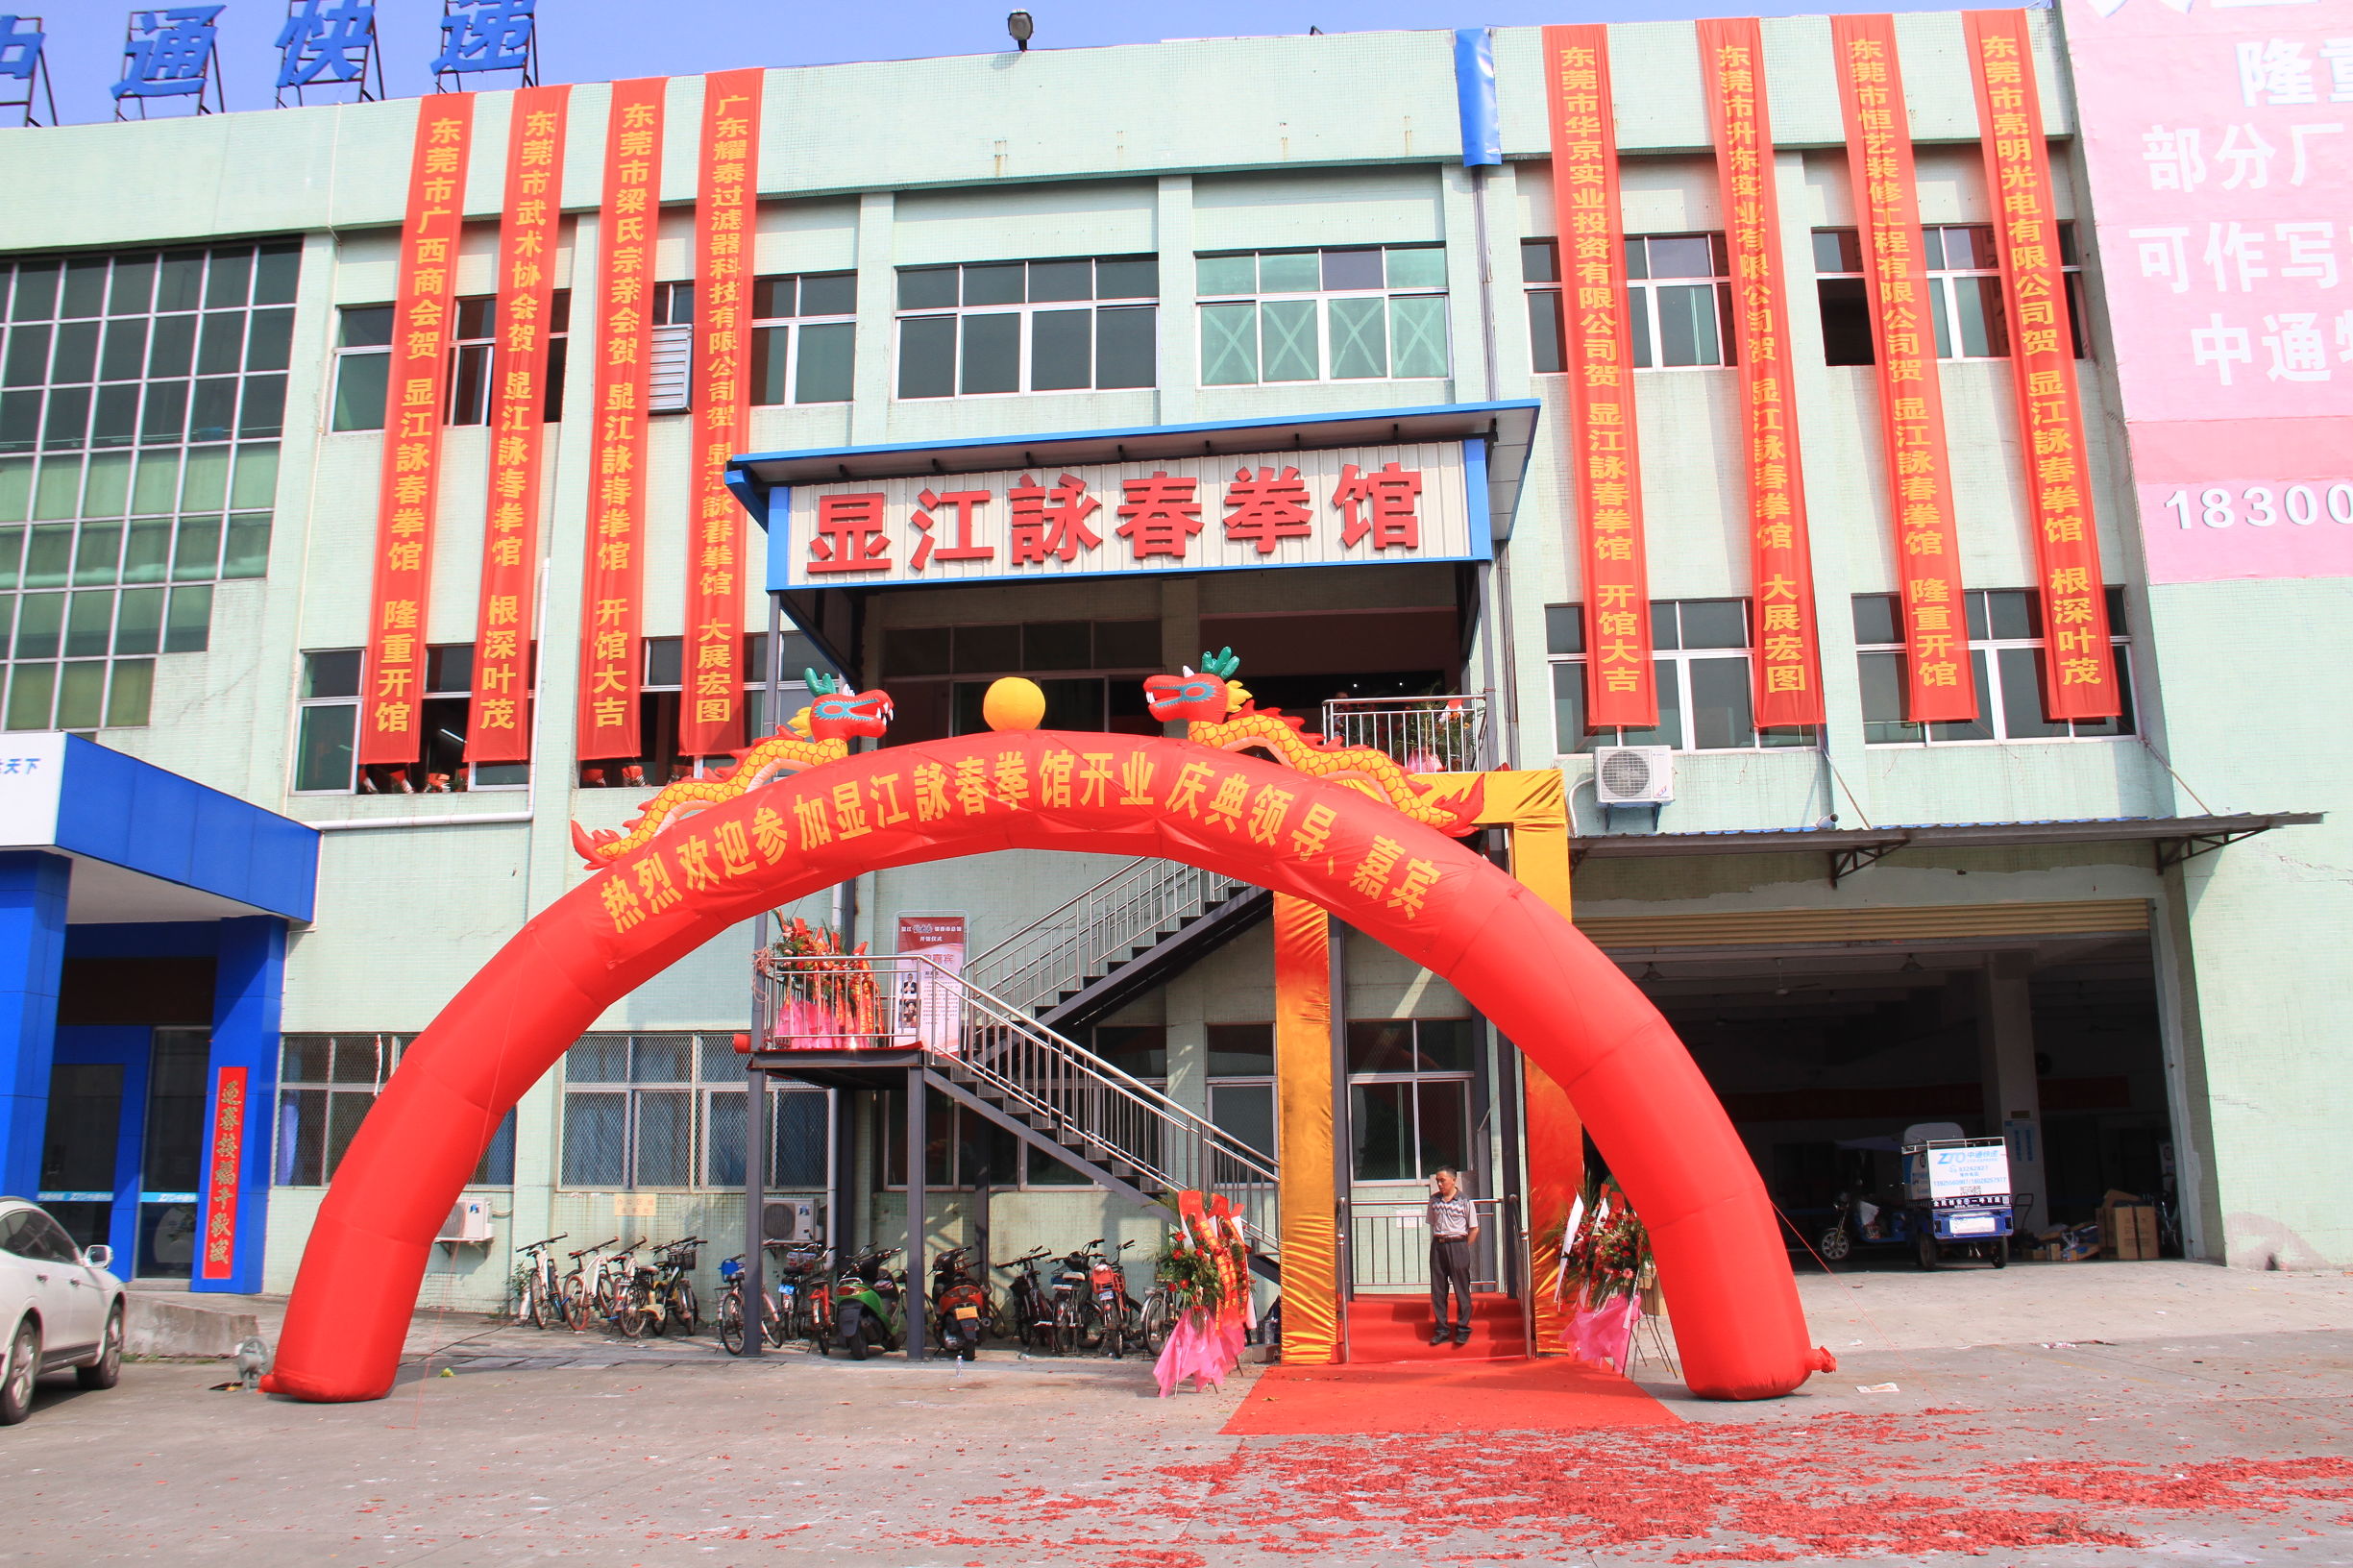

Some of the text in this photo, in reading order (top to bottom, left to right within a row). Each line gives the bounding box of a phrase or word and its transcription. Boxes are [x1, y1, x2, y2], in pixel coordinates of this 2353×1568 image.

[2142, 121, 2344, 192] 部分厂
[407, 117, 463, 360] 东莞市广西商会贺
[507, 110, 558, 354] 东莞市武术协会贺
[608, 103, 656, 366] 东莞市梁氏宗亲会贺
[706, 94, 749, 430] 广东耀泰过滤器科技有限公司贺
[2129, 220, 2353, 293] 可作写
[1559, 46, 1621, 387] 东莞市华京实业投资有限公司贺
[1597, 584, 1641, 692] 开馆大吉
[1716, 45, 1777, 364] 东莞市升东实业有限公司贺
[1760, 574, 1806, 694] 大展宏图
[1849, 38, 1924, 383] 东莞市恒艺装修工程有限公司贺
[1910, 577, 1958, 687] 隆重开馆
[1981, 36, 2060, 356] 东莞市亮明光电有限公司贺
[2049, 566, 2102, 685] 根深叶茂
[2190, 310, 2353, 386] 中通
[806, 461, 1422, 575] 显江詠春拳馆
[375, 599, 419, 733] 隆重开馆
[480, 594, 519, 729] 根深叶茂
[592, 598, 629, 727] 开馆大吉
[696, 618, 732, 723] 大展宏图
[0, 757, 41, 774] 天下
